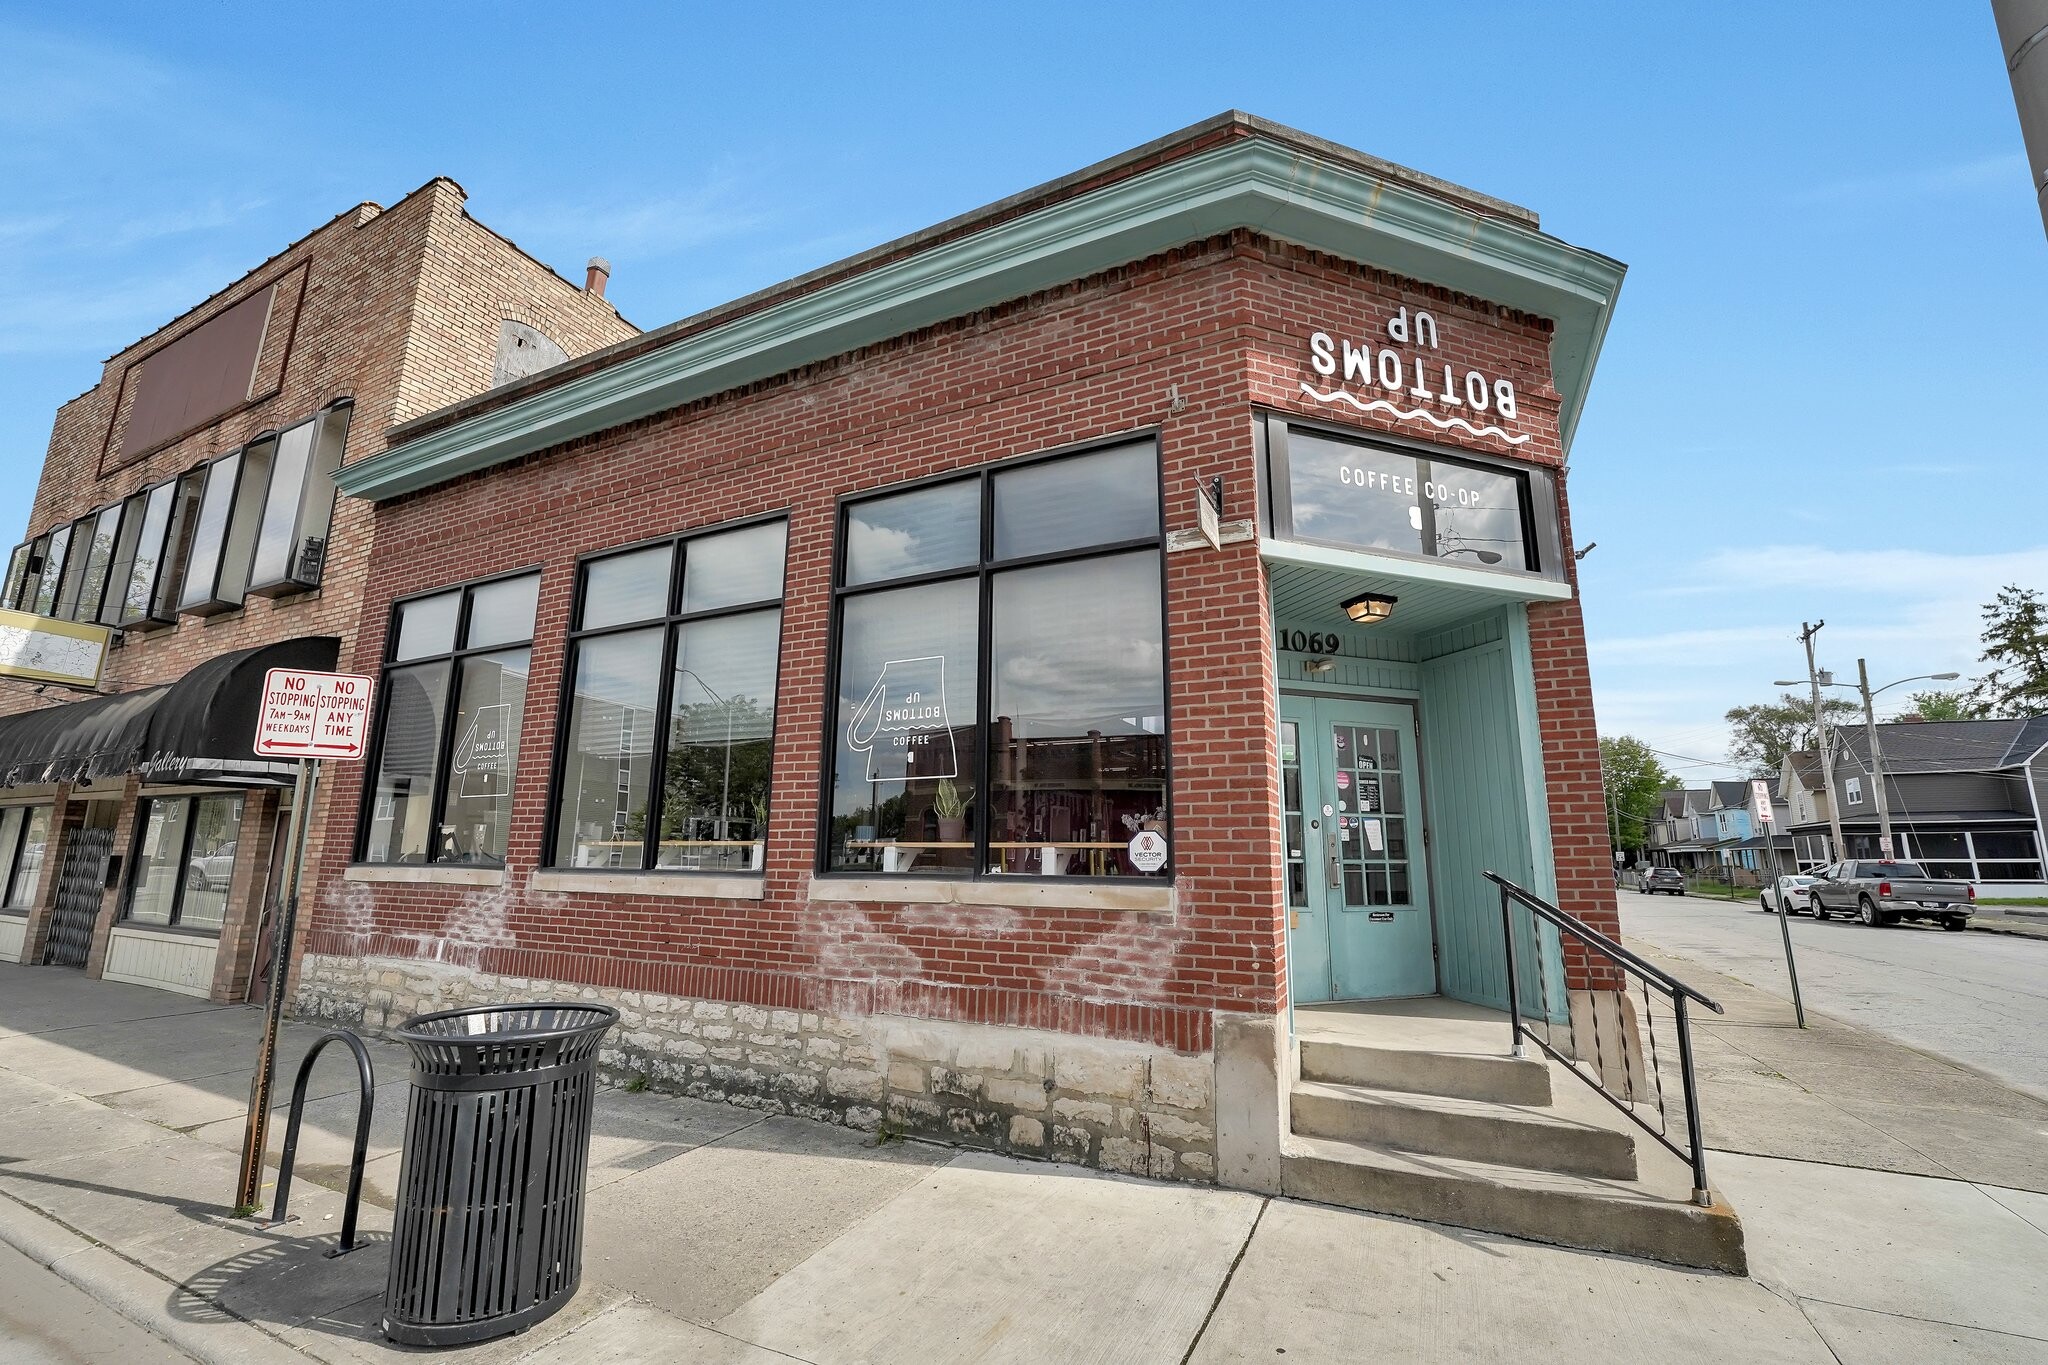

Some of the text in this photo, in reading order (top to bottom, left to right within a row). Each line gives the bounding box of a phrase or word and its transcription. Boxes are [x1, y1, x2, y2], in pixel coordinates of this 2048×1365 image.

[1387, 306, 1439, 349] UP
[1309, 331, 1517, 419] BOTTOMS
[1339, 465, 1481, 507] COFFEE CO-OP
[1279, 628, 1340, 655] 1069
[285, 677, 305, 691] NO
[334, 680, 355, 695] NO
[268, 691, 316, 708] STOPPING
[319, 695, 365, 711] STOPPING
[906, 692, 920, 704] UP
[326, 711, 354, 723] ANY
[886, 706, 940, 721] BOTTOMS
[265, 722, 310, 734] WEEKDAYS
[324, 724, 354, 737] TIME
[487, 730, 496, 739] UP
[475, 741, 505, 752] BOTTOMS
[893, 735, 929, 746] COFFEE
[146, 750, 189, 778] Gallery
[477, 762, 497, 770] COFFEE
